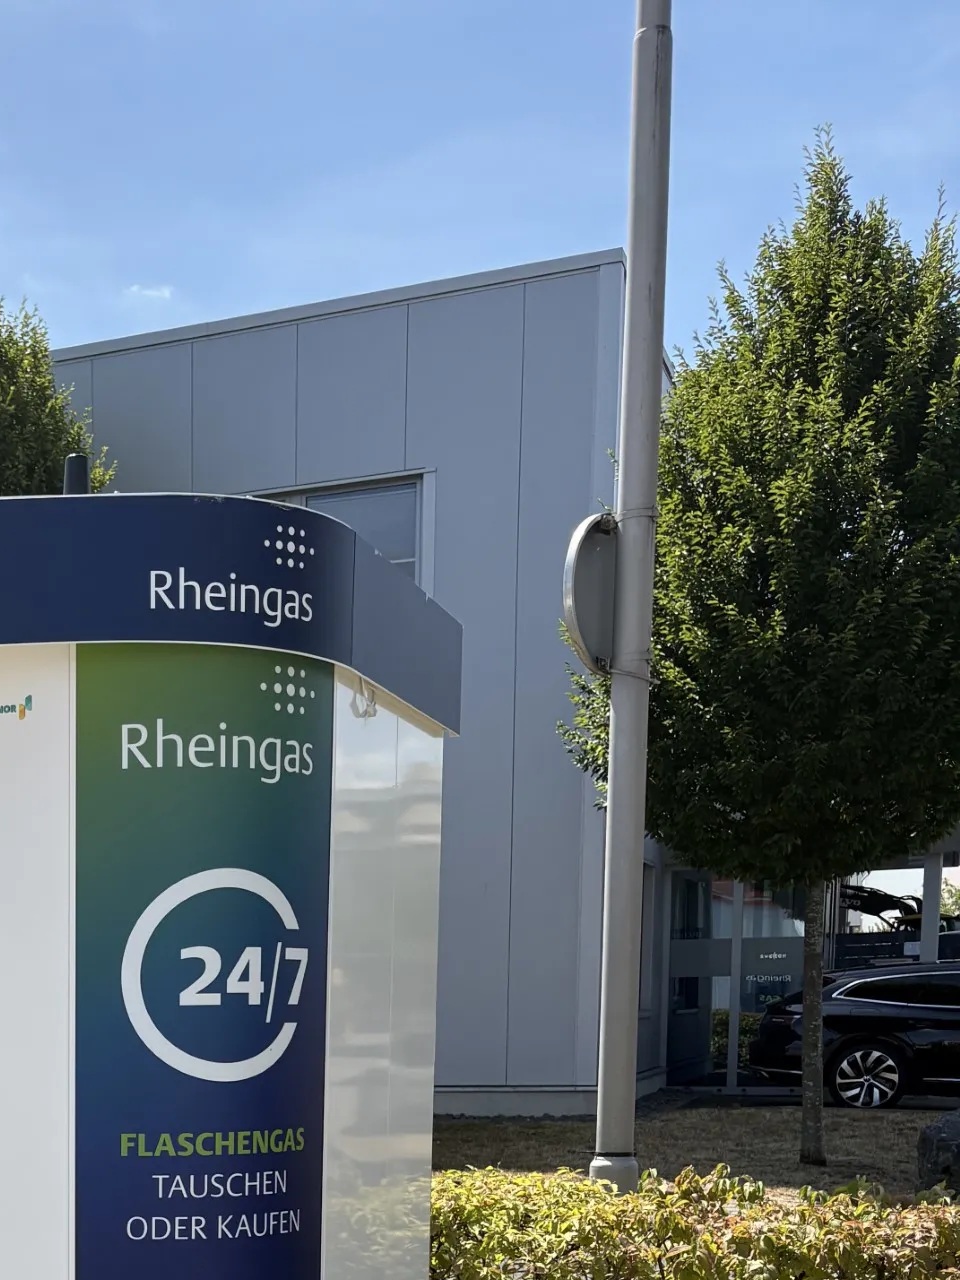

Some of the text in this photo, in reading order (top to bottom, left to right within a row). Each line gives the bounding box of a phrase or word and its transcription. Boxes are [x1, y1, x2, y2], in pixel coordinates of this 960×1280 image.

[148, 567, 314, 628] Rheingas
[120, 721, 314, 784] Rheingas
[178, 941, 309, 1024] 24/7
[119, 1127, 305, 1158] FLASCHENGAS
[152, 1169, 288, 1199] TAUSCHEN
[125, 1206, 302, 1242] ODER KAUFEN
